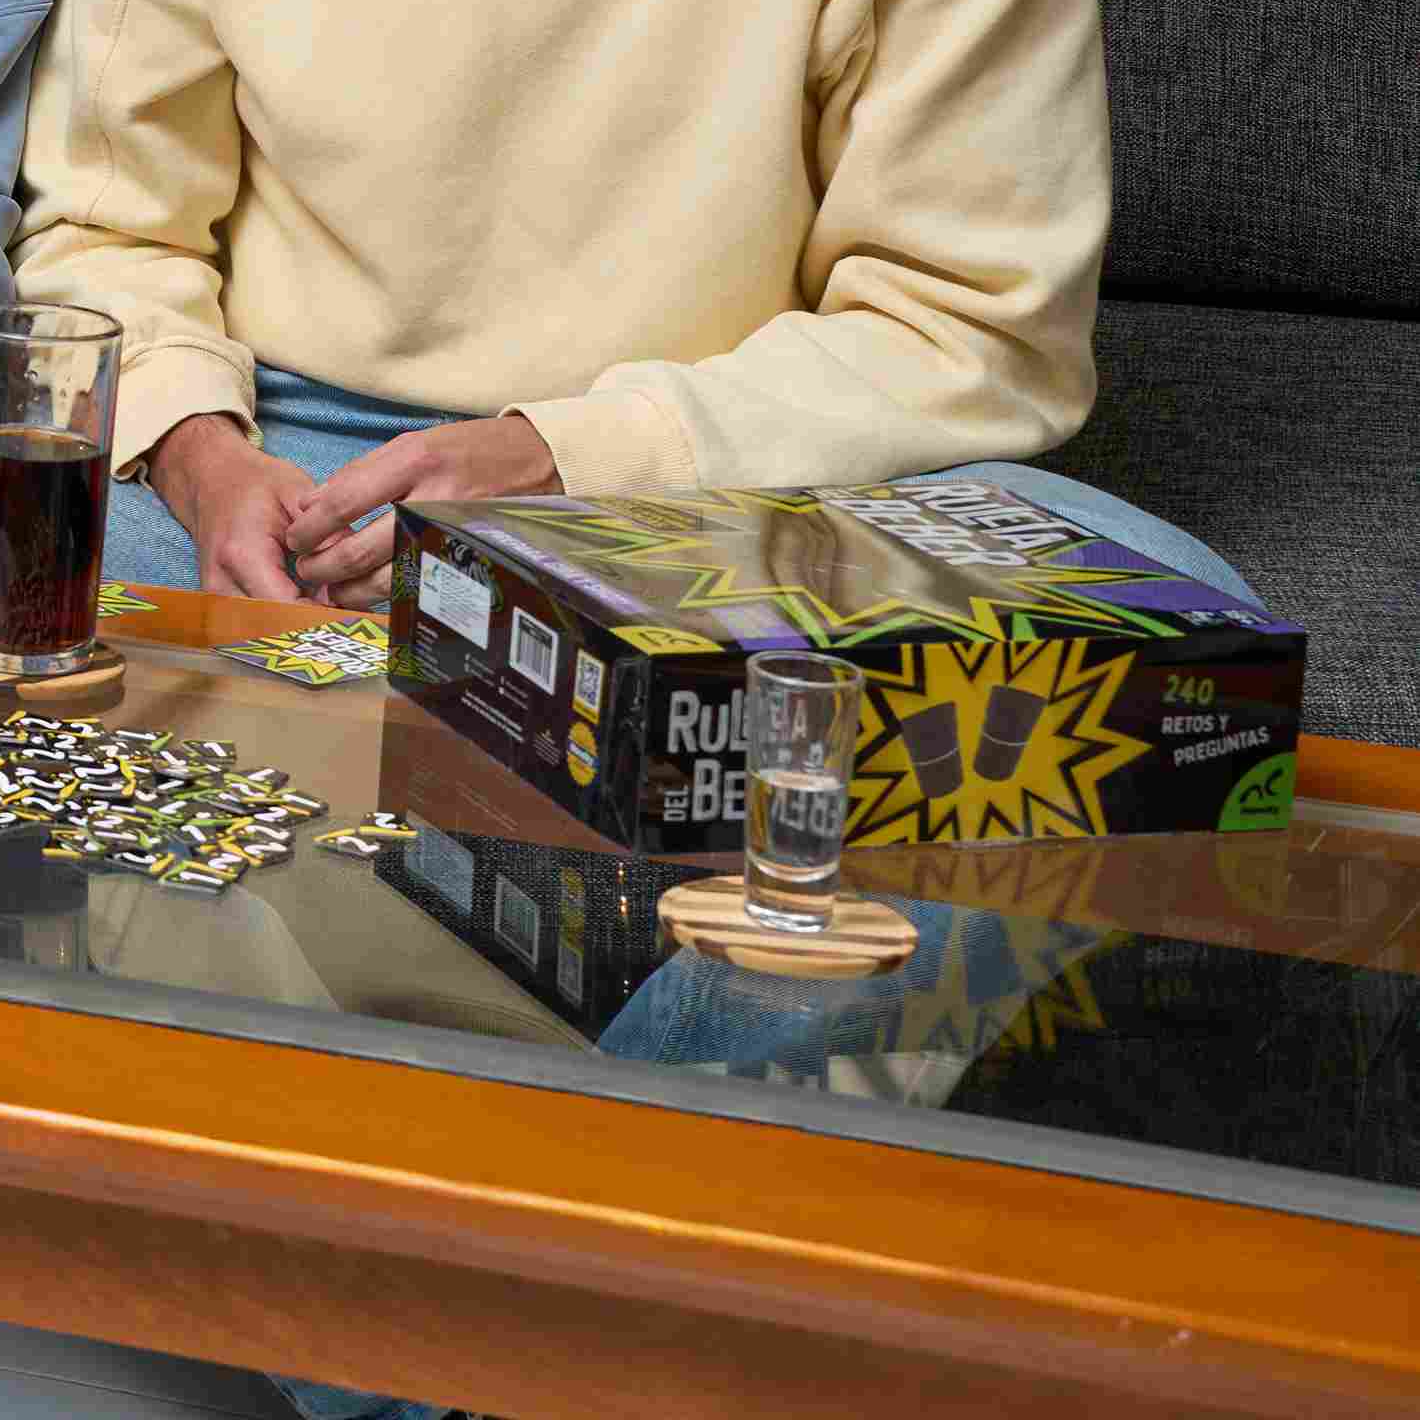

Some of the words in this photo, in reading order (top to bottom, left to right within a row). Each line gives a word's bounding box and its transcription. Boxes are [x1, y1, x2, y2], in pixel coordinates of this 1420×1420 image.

[822, 499, 1029, 567] BEBER
[893, 483, 1083, 551] RULETA
[282, 642, 379, 674] RULETA
[1163, 675, 1215, 705] 240
[1161, 715, 1214, 735] RETOS
[1217, 712, 1231, 732] Y
[1173, 725, 1271, 768] PREGUNTAS
[663, 784, 689, 822] DEL
